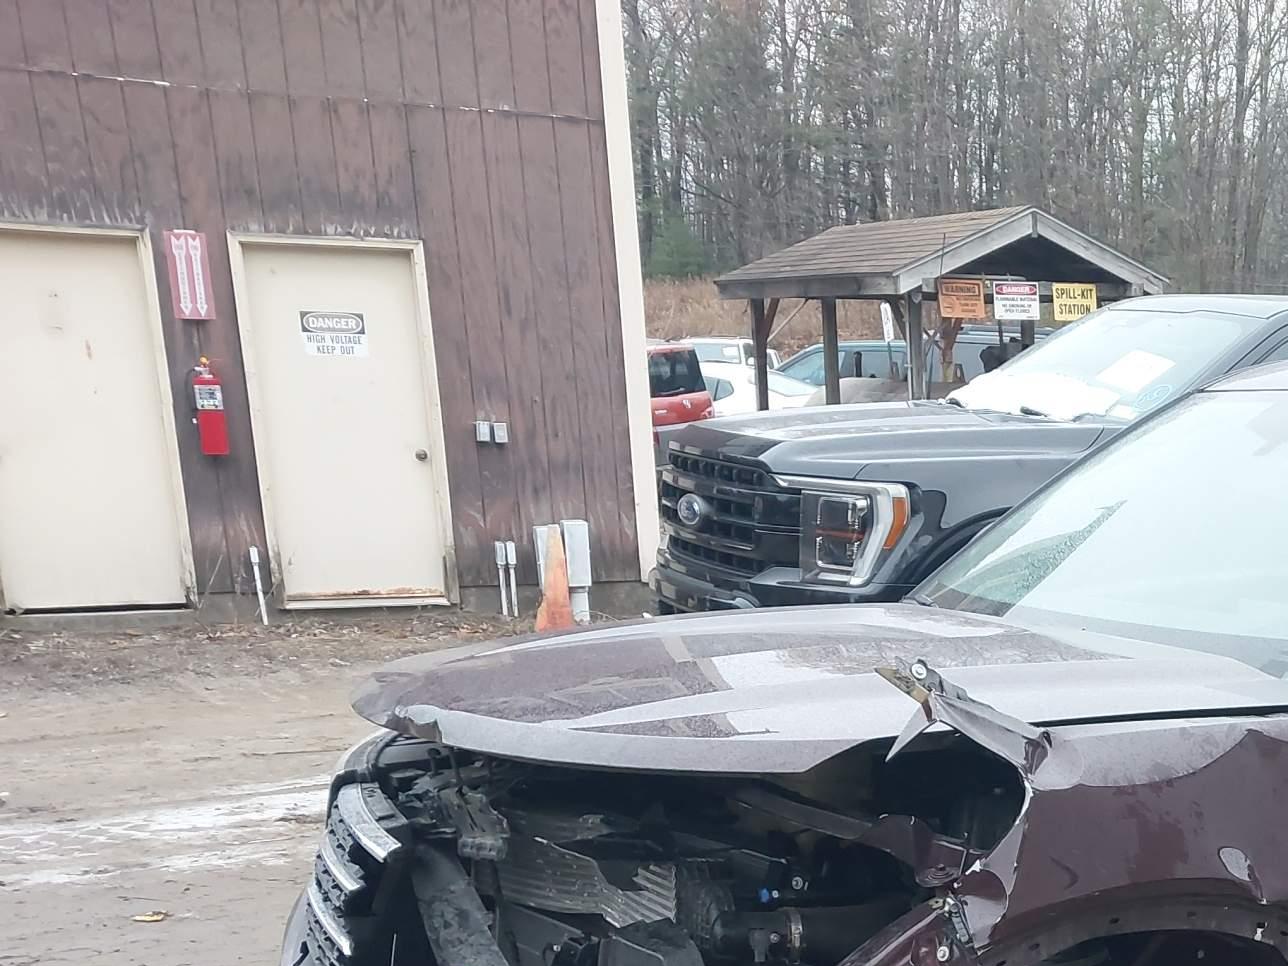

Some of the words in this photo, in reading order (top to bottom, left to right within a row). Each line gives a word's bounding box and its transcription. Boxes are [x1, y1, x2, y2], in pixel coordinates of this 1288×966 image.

[1055, 287, 1094, 300] SPILL-KIT
[1058, 303, 1091, 316] STATION
[308, 317, 357, 329] DANGER
[306, 334, 326, 344] HIGH
[330, 335, 363, 345] VOLTAGE
[316, 345, 336, 354] KEEP
[340, 345, 355, 355] OUT
